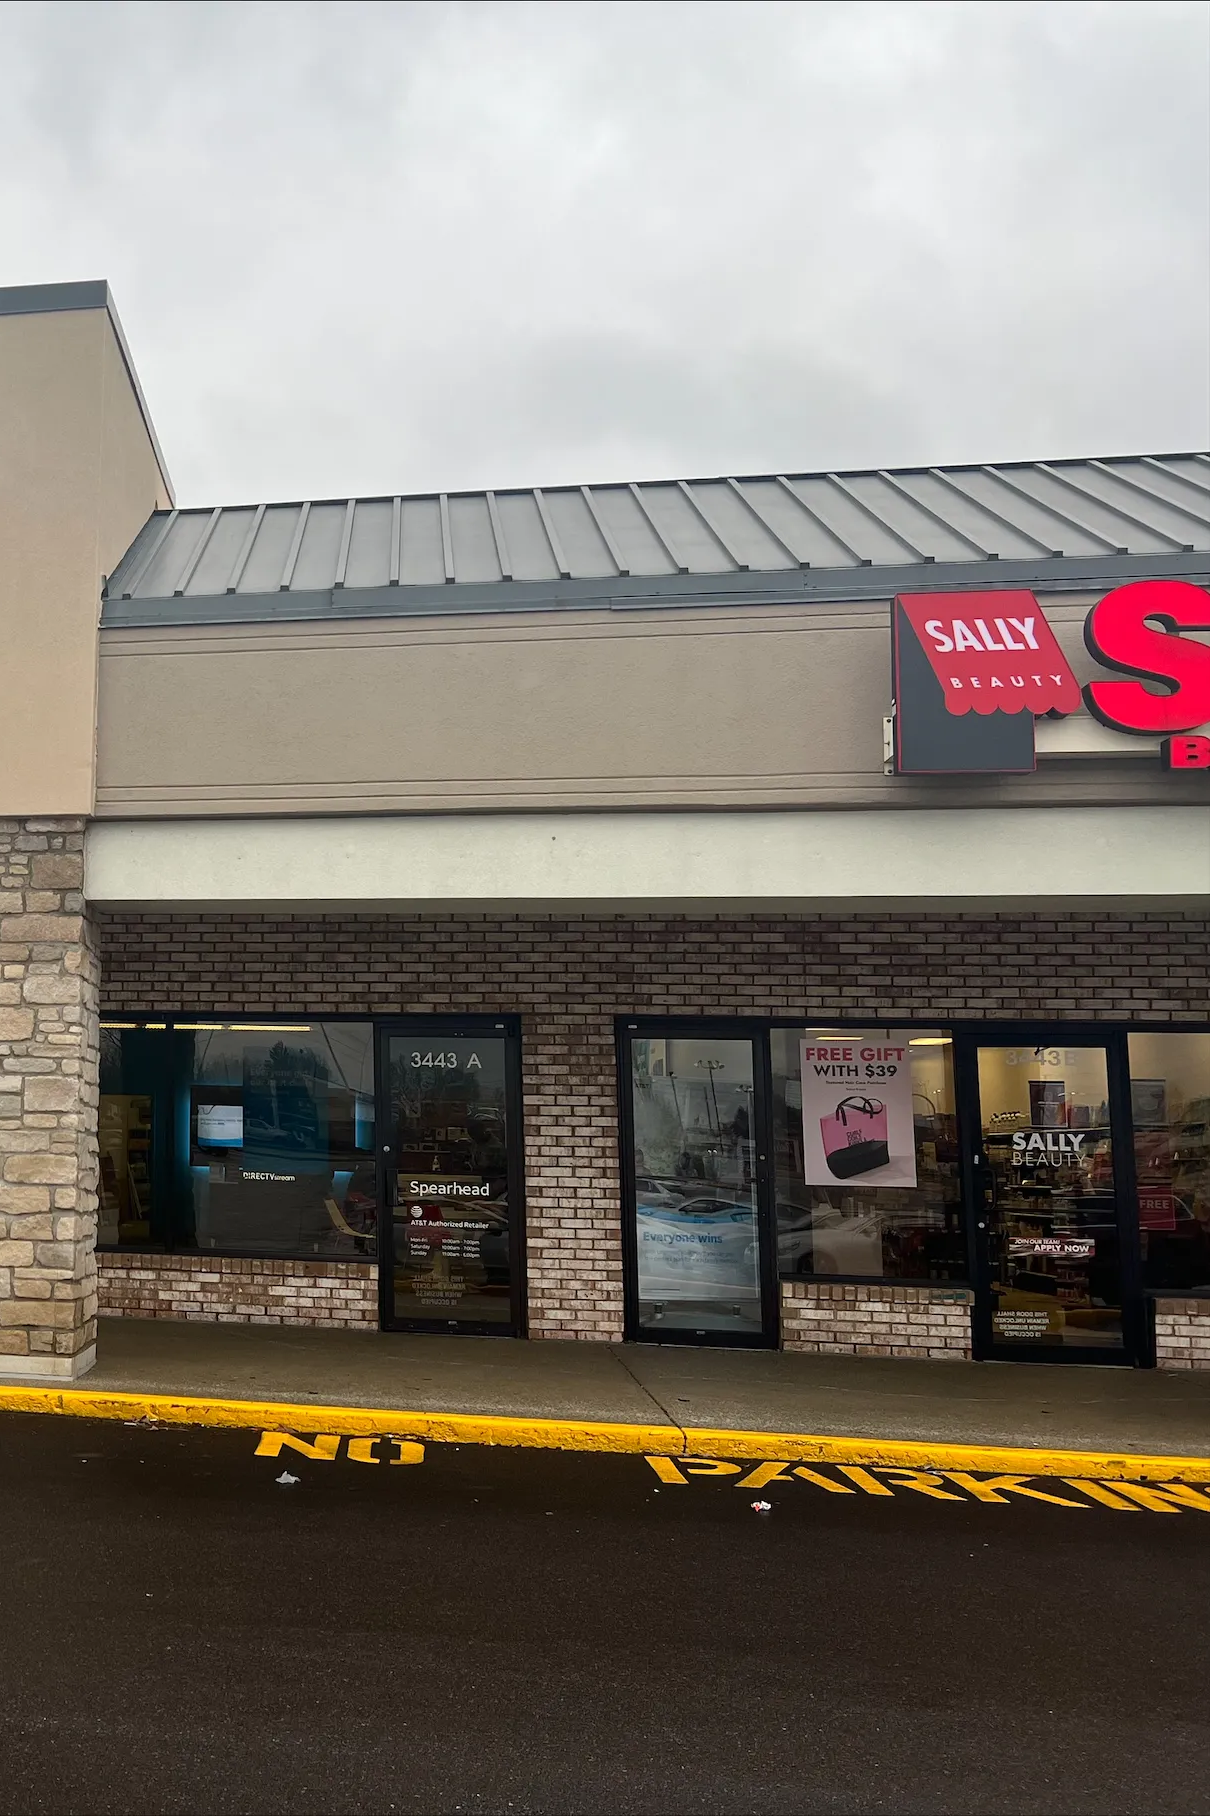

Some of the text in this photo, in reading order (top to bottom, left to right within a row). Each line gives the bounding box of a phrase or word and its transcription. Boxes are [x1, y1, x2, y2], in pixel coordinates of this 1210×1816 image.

[923, 616, 1040, 653] SALLY
[949, 674, 1063, 689] BEAUTY
[410, 1051, 482, 1069] 3443 A
[805, 1047, 905, 1062] FREE GIFT
[813, 1063, 898, 1079] WITH $39
[1012, 1131, 1086, 1152] SALLY
[1011, 1151, 1086, 1167] BEAUTY
[410, 1180, 490, 1197] Spearhead
[1139, 1199, 1170, 1209] FREE
[428, 1220, 463, 1228] Authorized
[464, 1221, 490, 1229] Retailer
[643, 1231, 723, 1244] Everyone wins
[1034, 1244, 1061, 1252] APPLY
[253, 1431, 425, 1466] NO
[643, 1455, 1210, 1513] PARKIN
